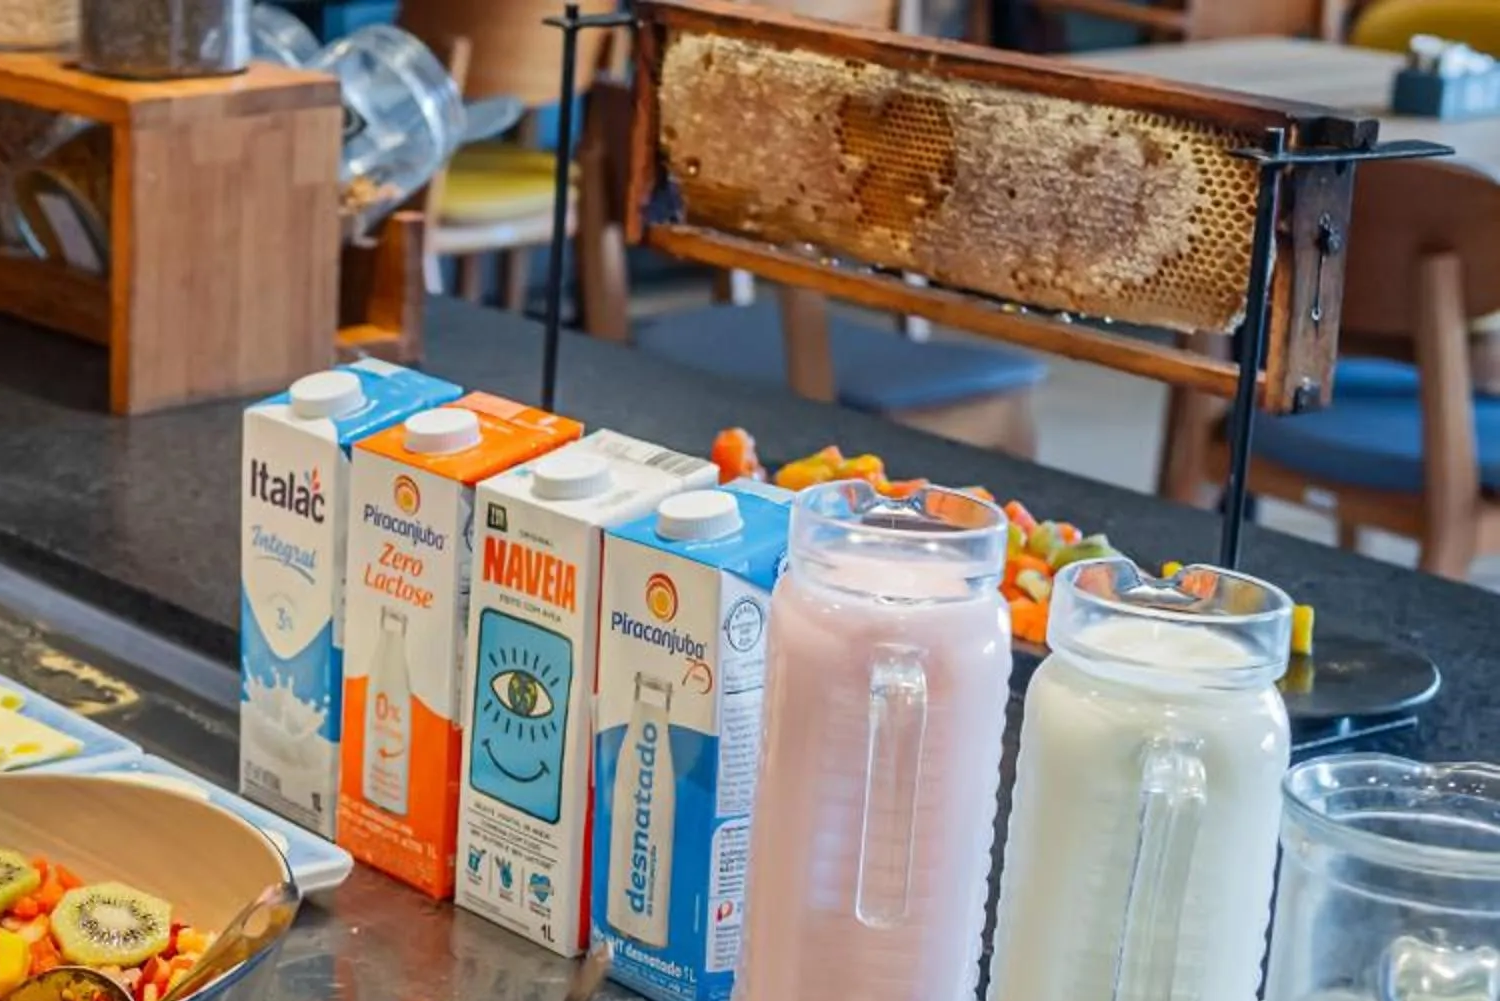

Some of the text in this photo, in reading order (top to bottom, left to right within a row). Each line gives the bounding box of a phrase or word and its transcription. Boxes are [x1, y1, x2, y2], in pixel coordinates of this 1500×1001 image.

[251, 458, 325, 524] Italac
[251, 525, 317, 570] Integral
[363, 503, 445, 551] Piracanjuba
[379, 542, 423, 577] Zero
[483, 535, 576, 614] NAVEIA
[364, 563, 434, 609] Lactose
[612, 610, 705, 660] Piracanjuba
[625, 723, 658, 914] desnatado
[541, 923, 555, 943] 1L
[625, 943, 682, 979] desnatado
